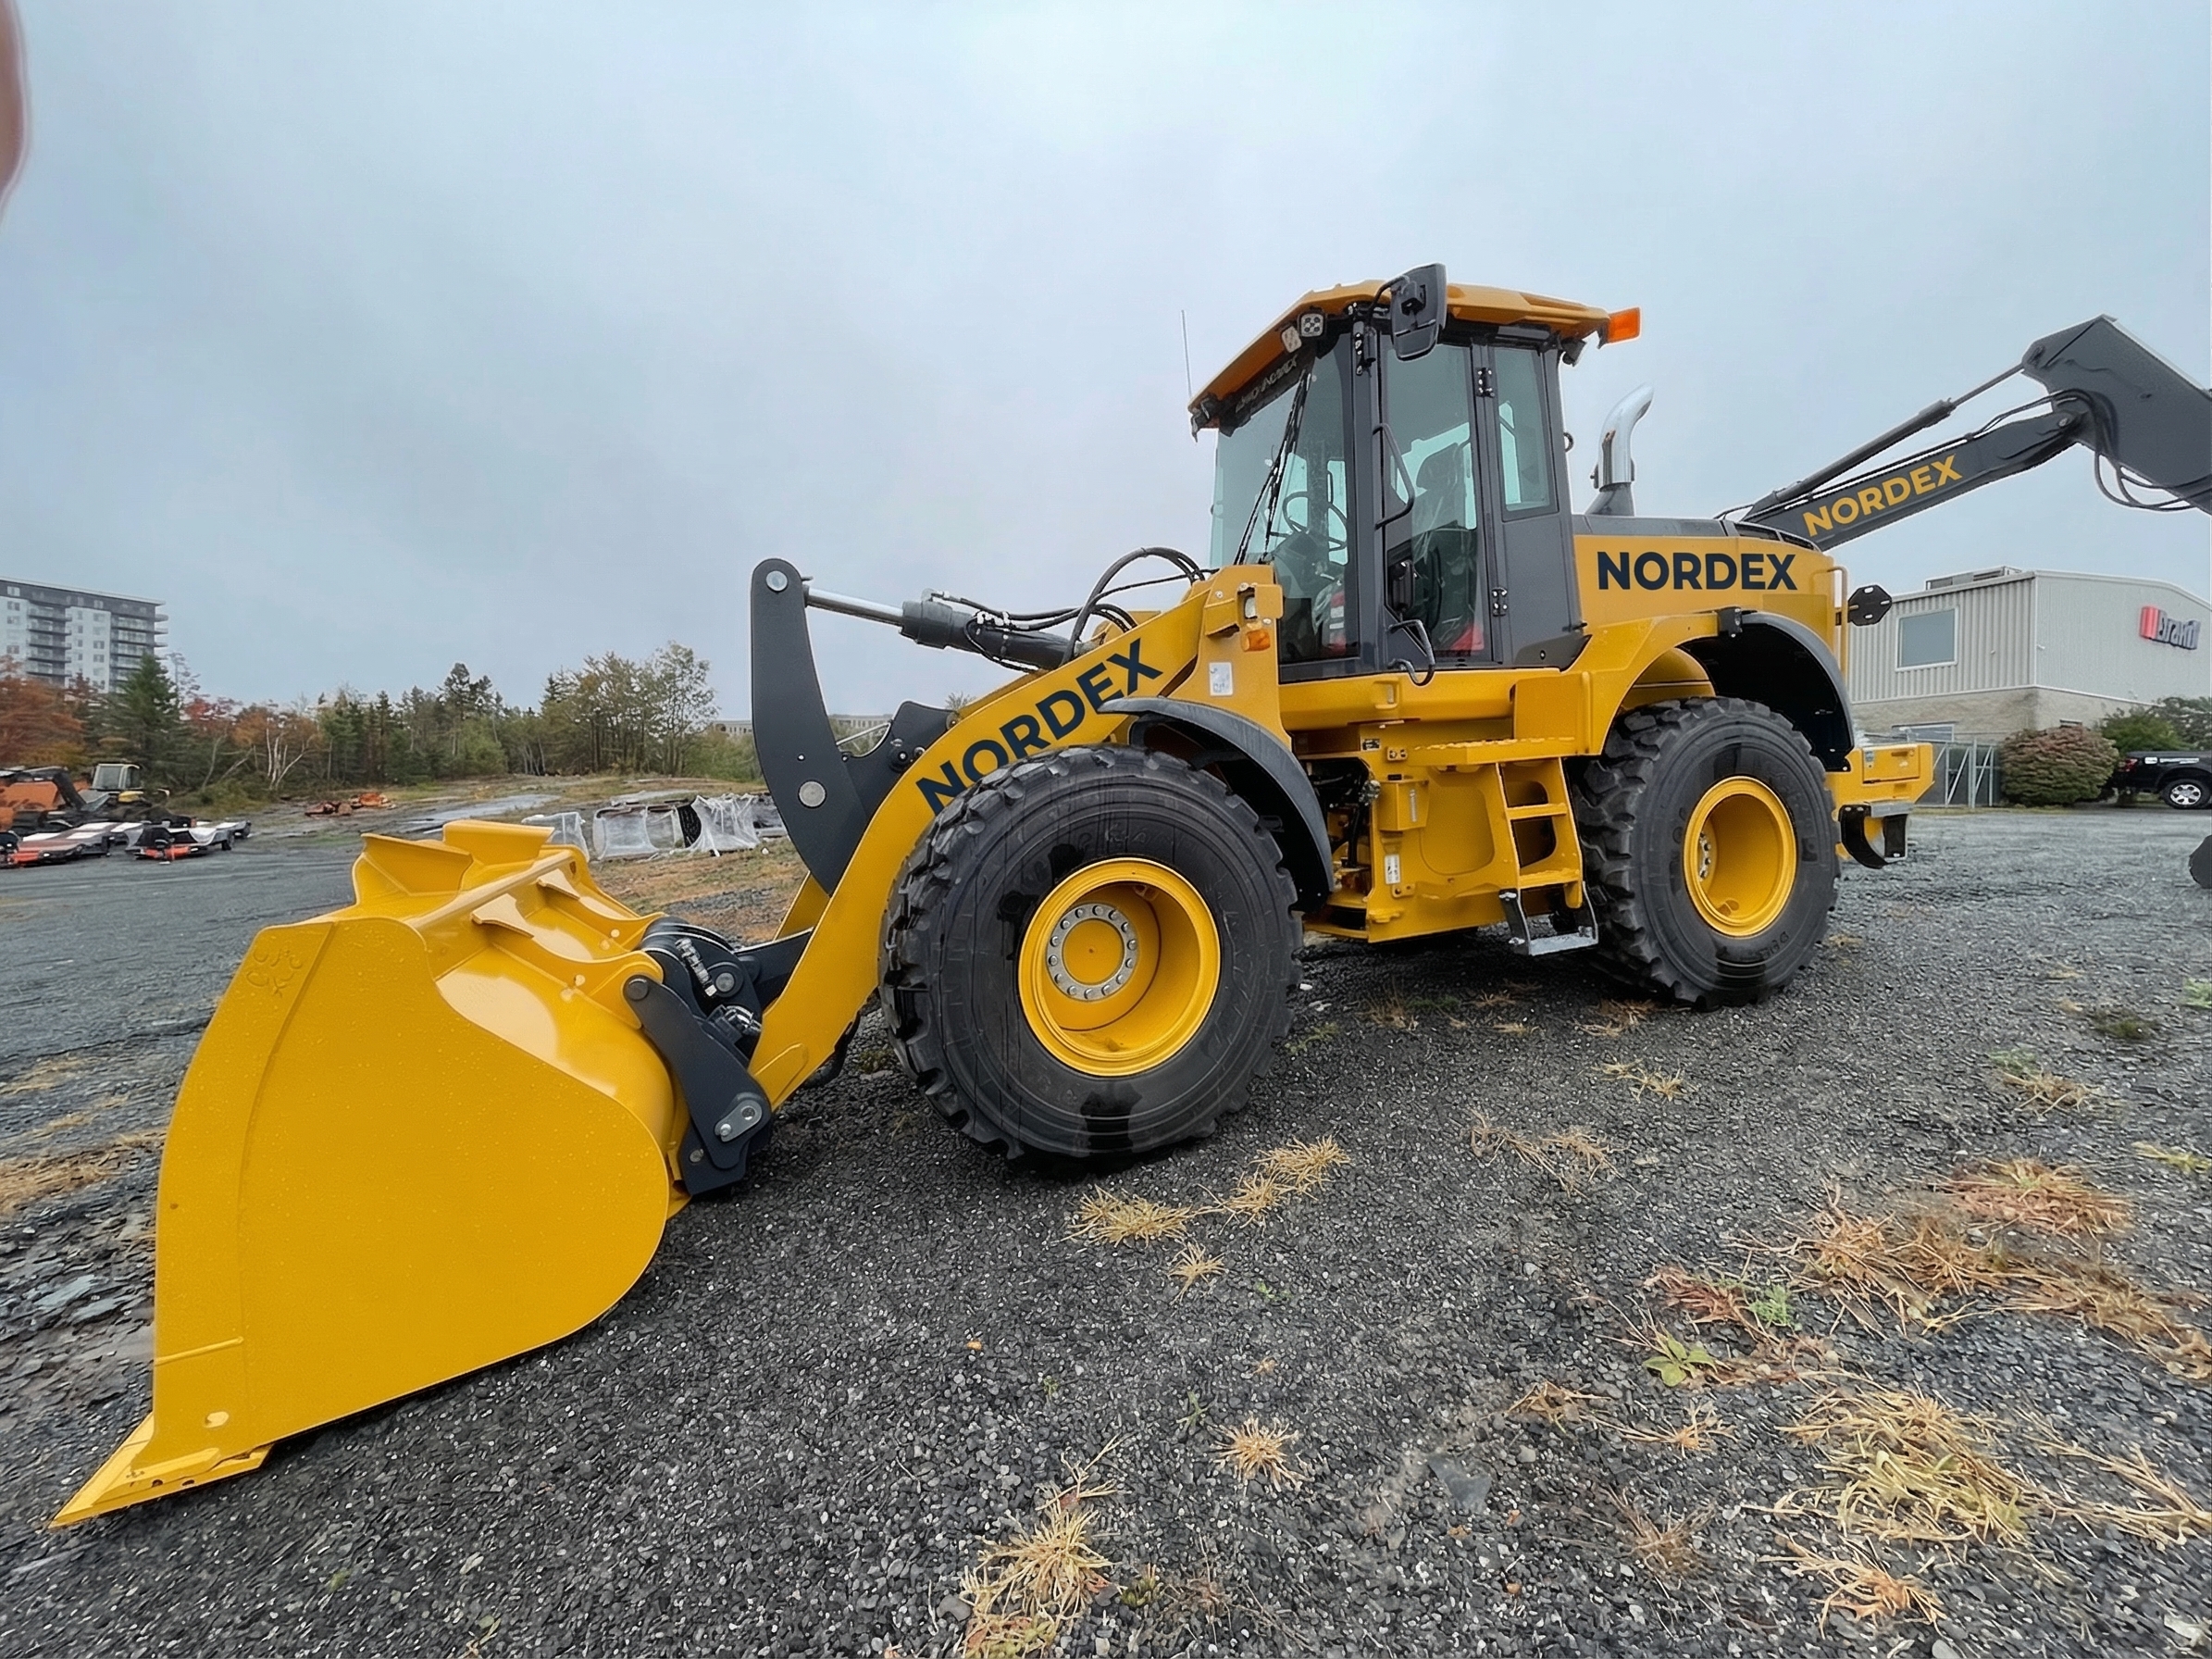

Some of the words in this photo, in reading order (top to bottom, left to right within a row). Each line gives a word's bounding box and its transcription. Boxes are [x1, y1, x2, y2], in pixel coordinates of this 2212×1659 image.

[1804, 455, 1961, 536] NORDEX
[1597, 551, 1798, 591] NORDEX
[916, 638, 1163, 816] NORDEX
